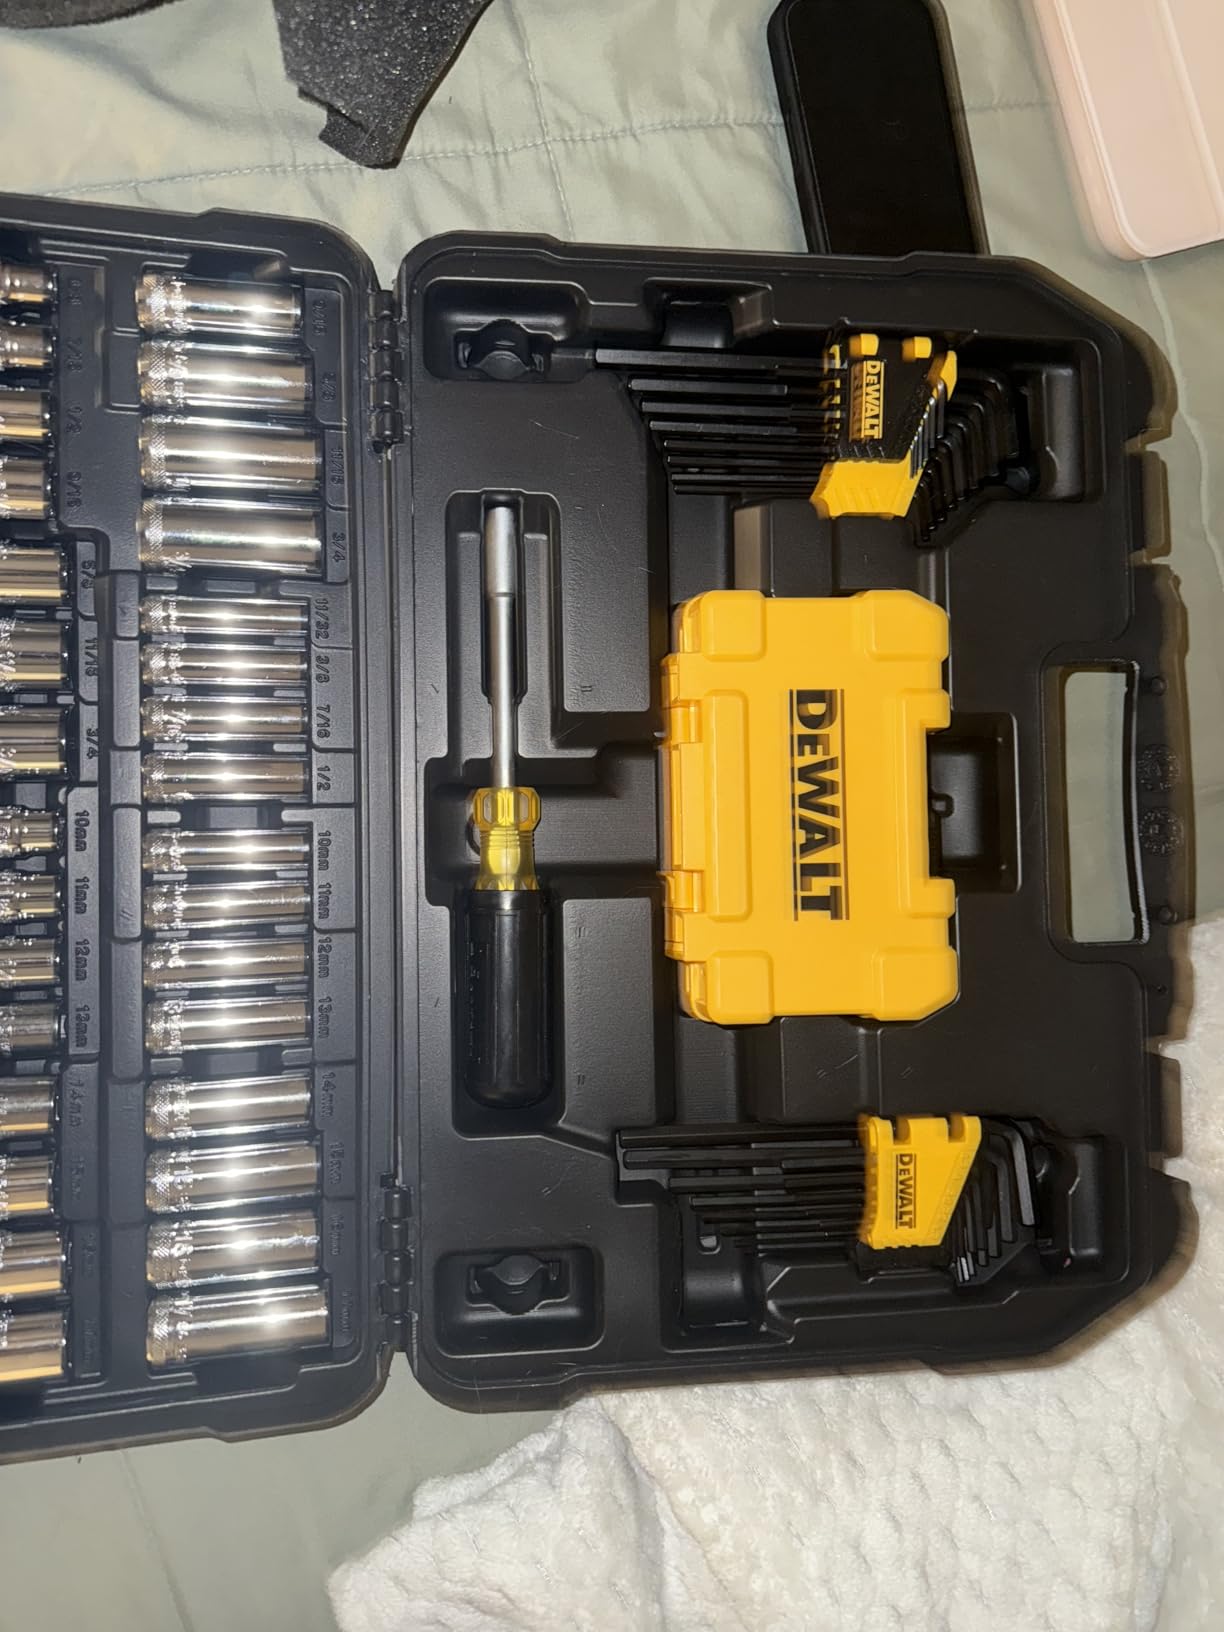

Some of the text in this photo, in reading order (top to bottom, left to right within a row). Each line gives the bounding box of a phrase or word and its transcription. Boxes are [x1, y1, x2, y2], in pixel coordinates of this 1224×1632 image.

[864, 360, 882, 439] DEWALT
[330, 531, 345, 563] 3/4
[315, 655, 329, 684] 3/8
[316, 704, 330, 739] 7/16
[316, 765, 330, 792] 1/2
[796, 689, 842, 921] DEWALT
[75, 810, 90, 852] 10mm
[317, 830, 331, 872] 10mm
[75, 876, 90, 914] 11mm
[317, 882, 331, 920] 11mm
[75, 939, 90, 982] 12mm
[317, 936, 331, 979] 12mm
[75, 1005, 90, 1048] 13mm
[317, 996, 331, 1039] 13mm
[898, 1153, 913, 1229] DEWALT
